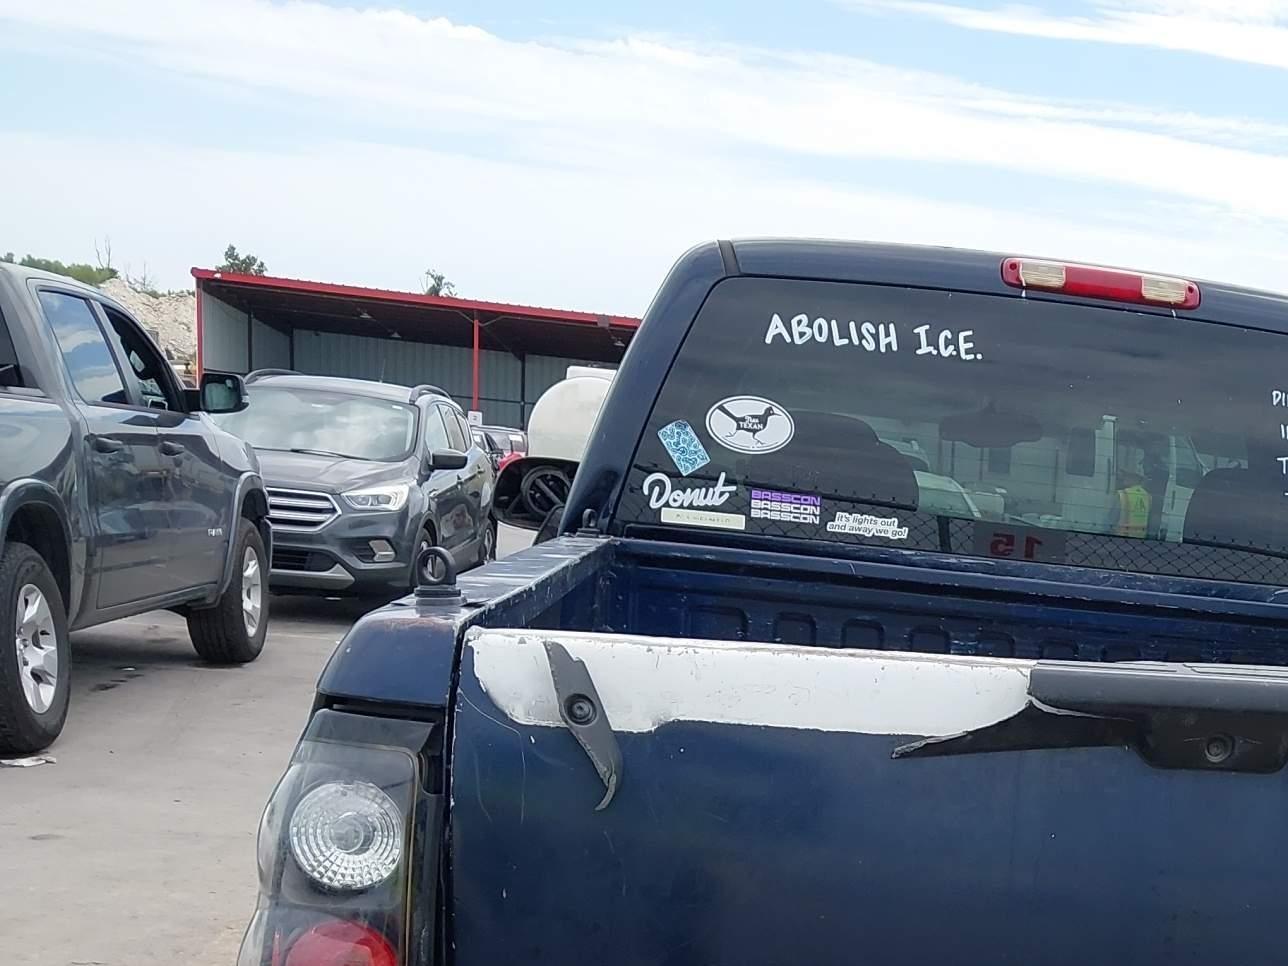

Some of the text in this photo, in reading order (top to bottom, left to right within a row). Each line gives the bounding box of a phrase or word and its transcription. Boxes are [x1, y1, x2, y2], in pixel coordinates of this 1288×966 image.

[765, 313, 984, 360] ABOLISH I.C.E.
[738, 421, 764, 430] TEXAN
[643, 471, 737, 509] Donut
[751, 490, 821, 506] BASSCON
[750, 499, 821, 515] BASSCON
[750, 509, 820, 525] BASSCON
[837, 513, 896, 527] it's lights out
[828, 523, 847, 531] and
[848, 525, 873, 535] away
[891, 529, 907, 538] go!
